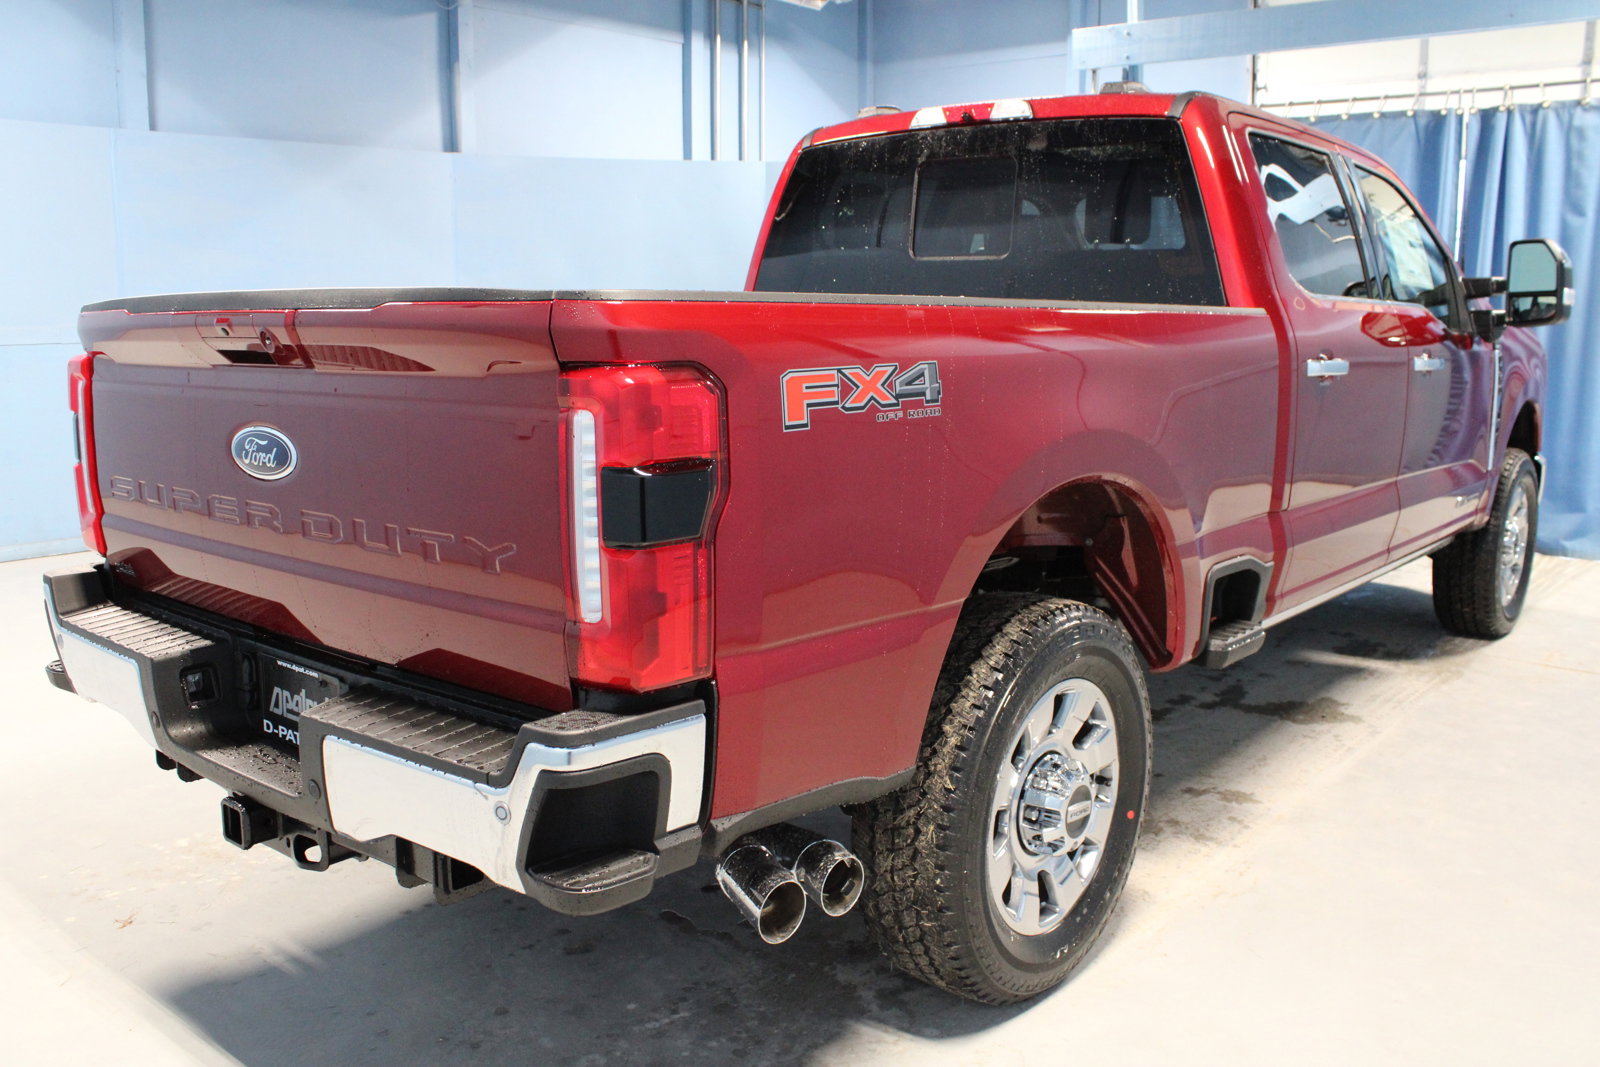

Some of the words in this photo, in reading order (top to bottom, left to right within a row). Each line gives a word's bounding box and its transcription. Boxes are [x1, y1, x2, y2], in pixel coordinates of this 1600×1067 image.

[780, 360, 942, 432] FX4
[876, 410, 903, 423] OFF
[907, 407, 942, 419] ROAD
[242, 437, 277, 468] Ford
[110, 475, 284, 534] SUPER
[301, 508, 517, 574] DUTY
